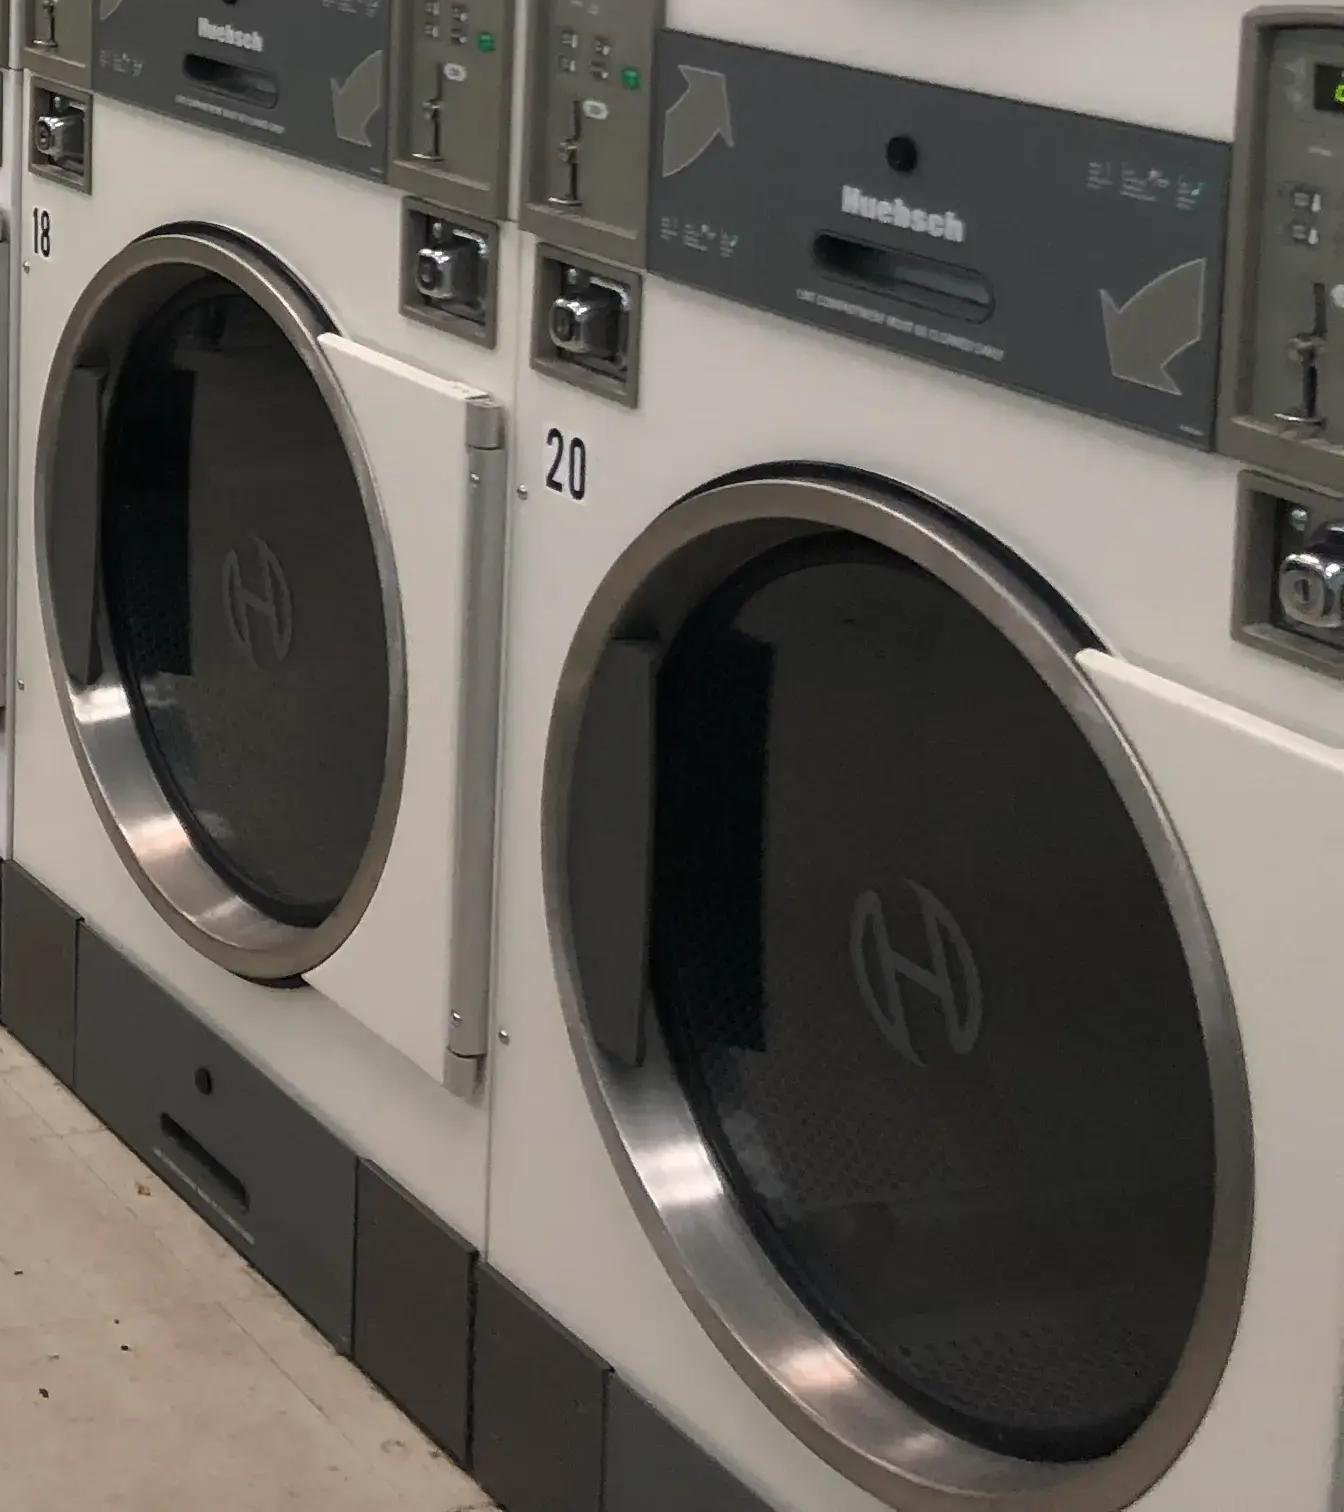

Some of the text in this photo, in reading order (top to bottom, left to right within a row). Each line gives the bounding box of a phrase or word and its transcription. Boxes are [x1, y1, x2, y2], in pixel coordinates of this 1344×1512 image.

[197, 16, 264, 53] Huebsch
[32, 207, 52, 258] 18
[840, 184, 964, 243] Huebsch
[546, 427, 587, 501] 20
